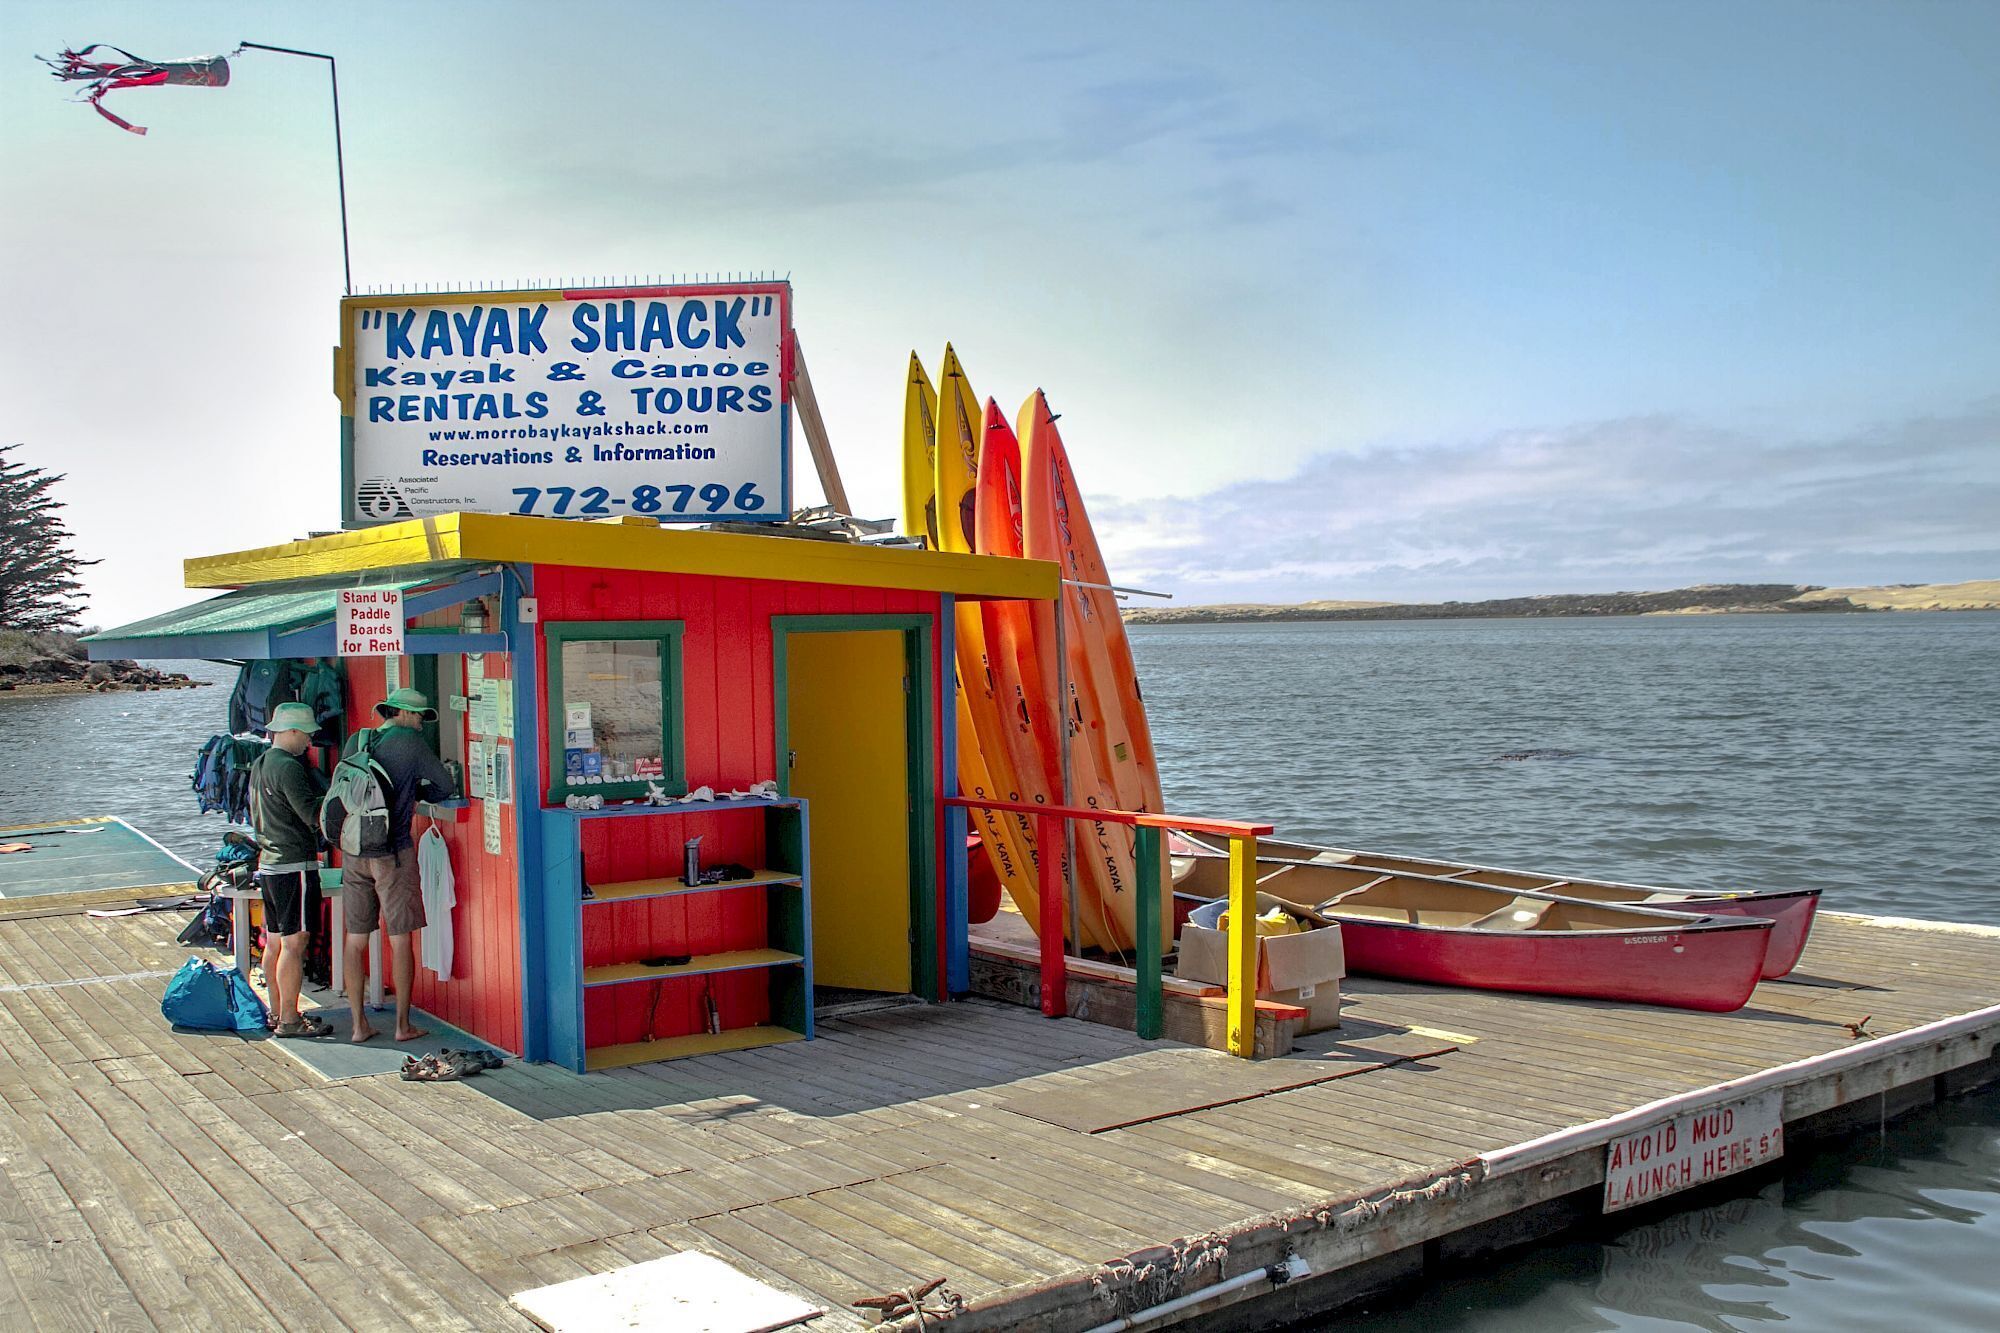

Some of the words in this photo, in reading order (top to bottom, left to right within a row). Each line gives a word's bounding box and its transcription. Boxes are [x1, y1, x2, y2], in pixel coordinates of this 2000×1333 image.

[365, 362, 516, 390] Kayak
[547, 362, 586, 381] &
[611, 357, 770, 379] Canoe
[368, 390, 548, 422] RENTALS
[576, 390, 606, 416] &
[631, 385, 773, 414] TOURS
[428, 421, 709, 442] www.morrobaykayakshack.com
[422, 448, 553, 467] Reservations
[565, 447, 582, 463] &
[593, 443, 716, 461] Information
[399, 476, 438, 484] Associated
[411, 497, 462, 505] Constructors,
[512, 483, 765, 514] 772-8796
[343, 591, 377, 603] Stand
[382, 591, 398, 605] Up
[351, 608, 391, 620] Paddle
[350, 623, 393, 635] Boards
[343, 639, 362, 653] for
[369, 639, 400, 652] Rent
[1009, 791, 1029, 832] OAN
[974, 786, 996, 825] OAN
[996, 842, 1016, 878] KAYAK
[1087, 796, 1106, 837] OAN
[1104, 856, 1124, 893] KAYAK
[1624, 935, 1668, 945] DSCOVERY
[1611, 1121, 1677, 1170] AVOID
[1692, 1108, 1734, 1144] MUD
[1608, 1156, 1691, 1206] LAUNCH
